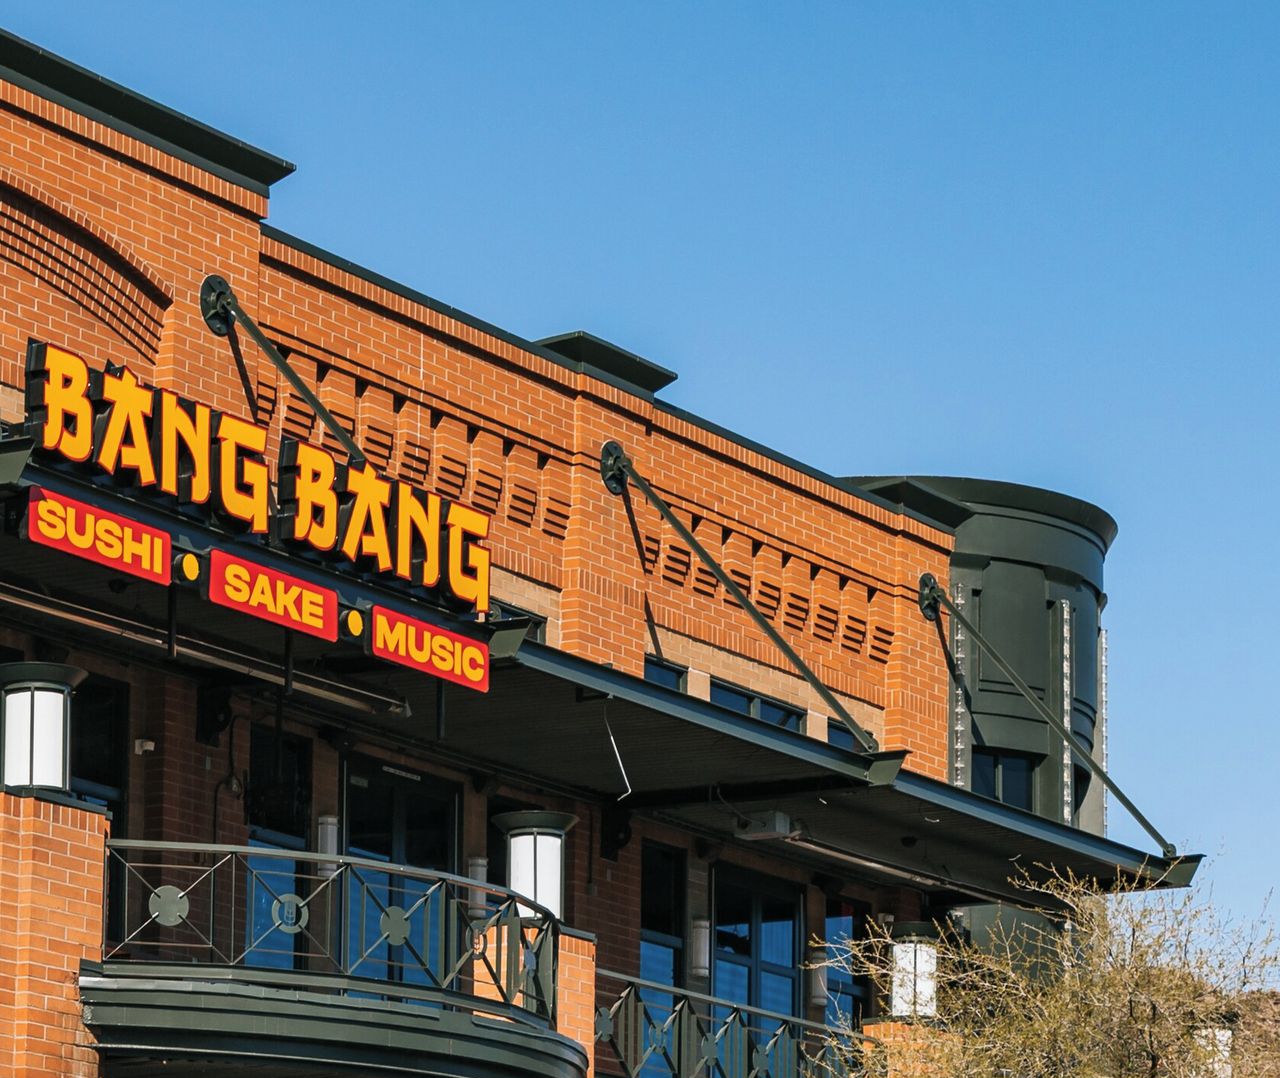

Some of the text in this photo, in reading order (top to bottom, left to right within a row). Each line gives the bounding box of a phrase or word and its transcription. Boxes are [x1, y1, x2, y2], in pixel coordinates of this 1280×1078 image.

[37, 498, 485, 683] SUSHI SAKE MUSIC
[42, 342, 492, 613] BANG BANG
